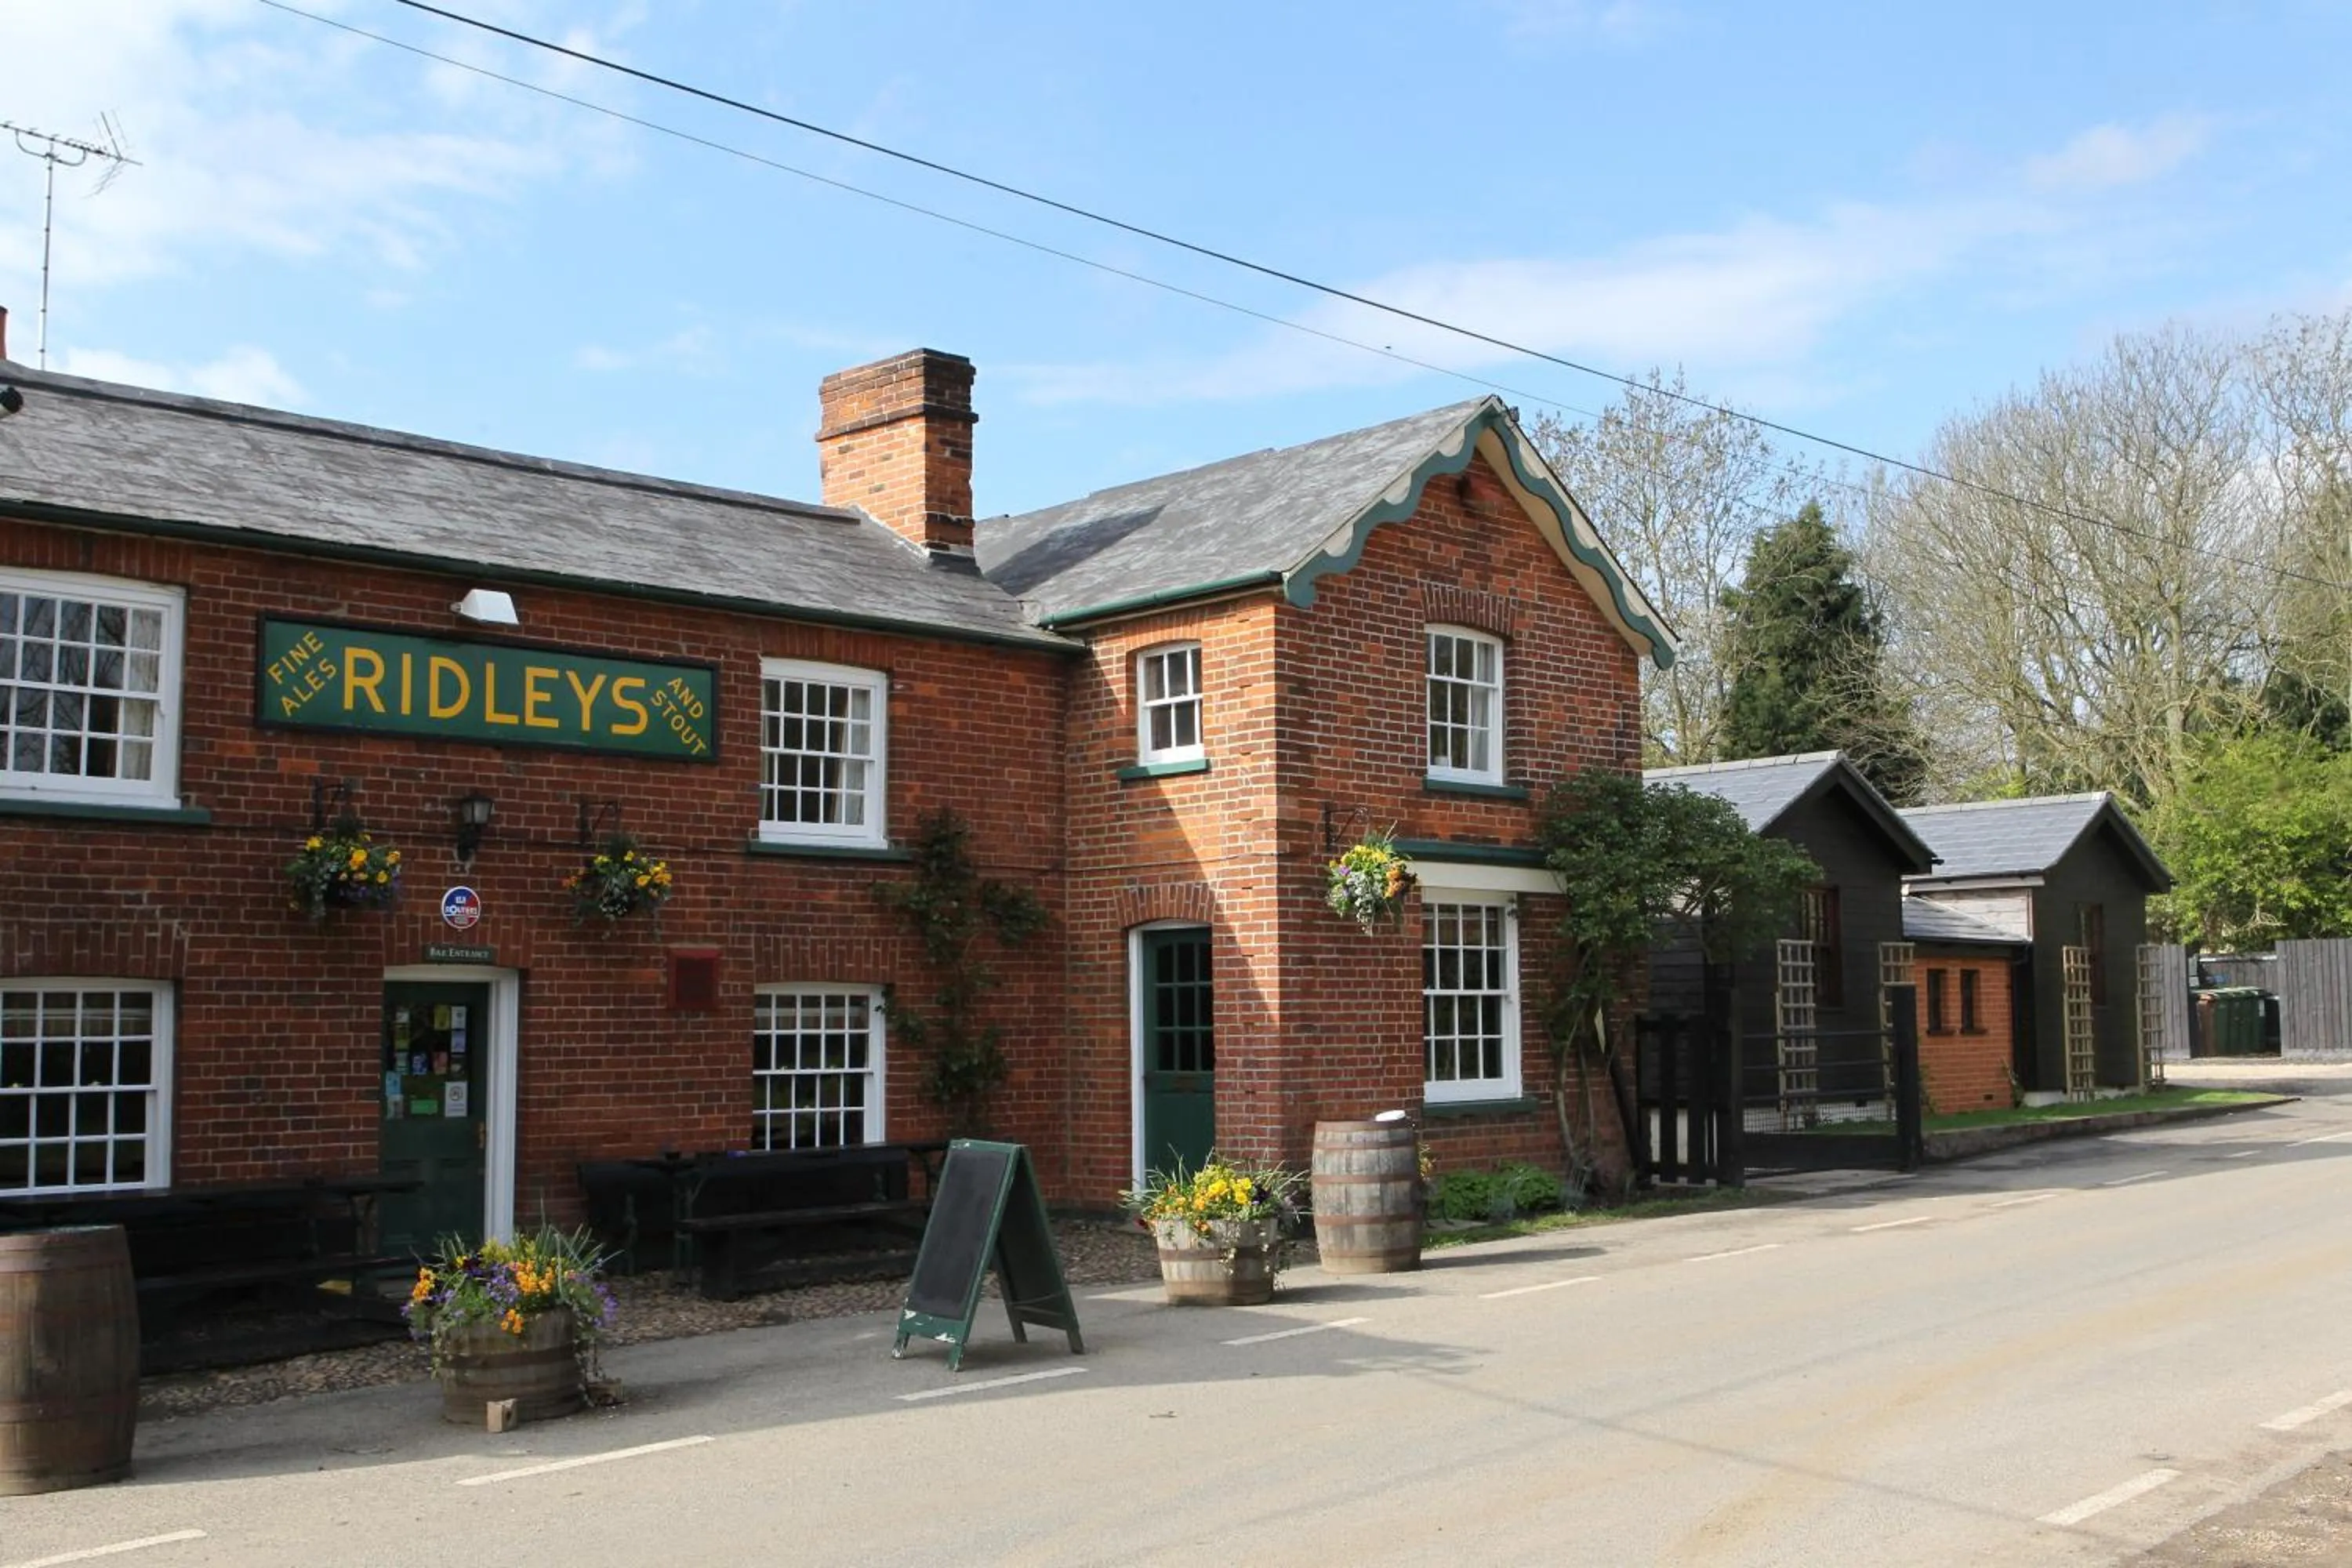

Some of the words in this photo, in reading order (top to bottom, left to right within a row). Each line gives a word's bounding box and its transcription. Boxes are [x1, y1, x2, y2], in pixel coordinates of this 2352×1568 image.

[267, 631, 324, 684] FINE
[281, 659, 337, 717] ALES
[342, 646, 650, 736] RIDLEYS
[666, 677, 703, 719] AND
[650, 690, 706, 755] STOUT
